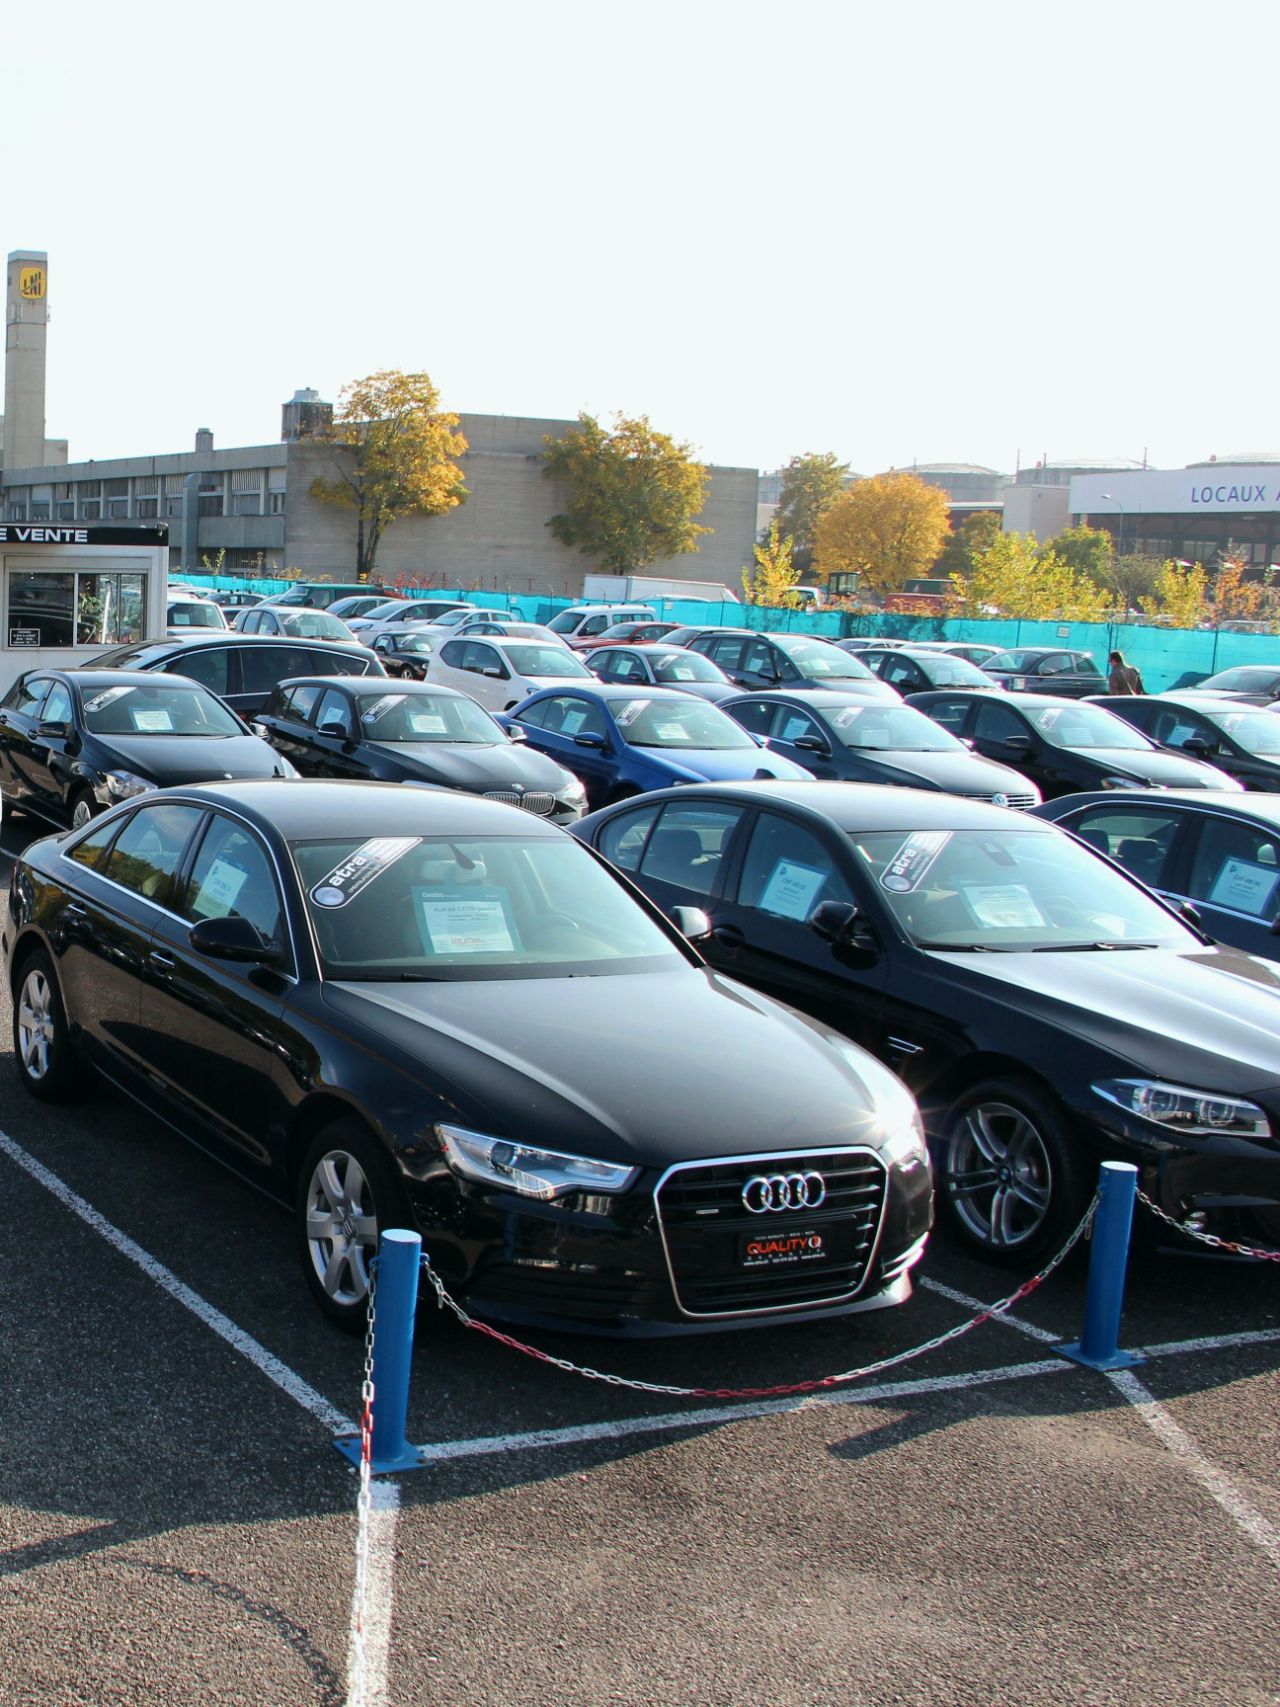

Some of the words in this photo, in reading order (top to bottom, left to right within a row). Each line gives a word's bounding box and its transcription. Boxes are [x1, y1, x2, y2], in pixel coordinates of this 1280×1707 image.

[1190, 485, 1267, 504] LOCAUX
[16, 528, 89, 544] VENTE
[891, 847, 917, 876] atra
[328, 856, 368, 887] atra
[747, 1237, 808, 1255] QUALITY
